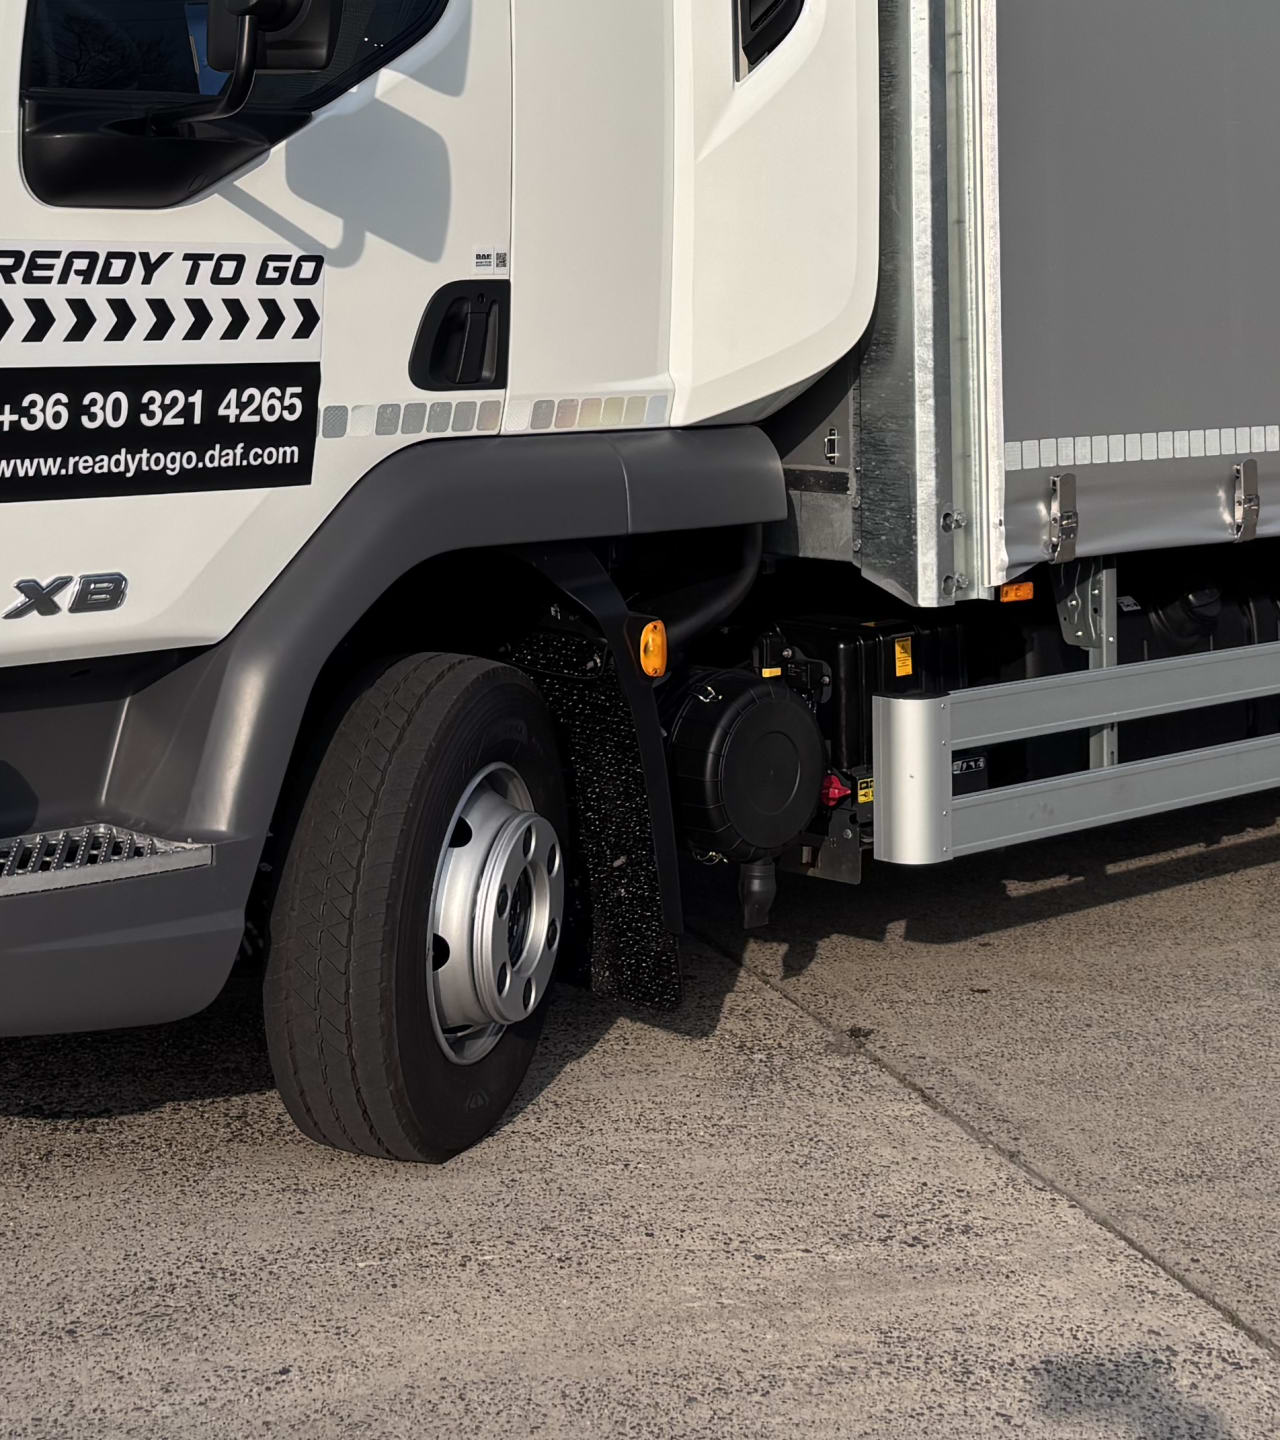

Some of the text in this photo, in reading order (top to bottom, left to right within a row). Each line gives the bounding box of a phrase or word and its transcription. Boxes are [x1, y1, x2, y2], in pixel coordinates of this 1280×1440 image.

[181, 252, 247, 286] TO
[255, 253, 325, 287] GO
[80, 390, 129, 429] 30
[139, 389, 203, 427] 321
[217, 386, 303, 424] 4265
[1, 571, 129, 620] XB
